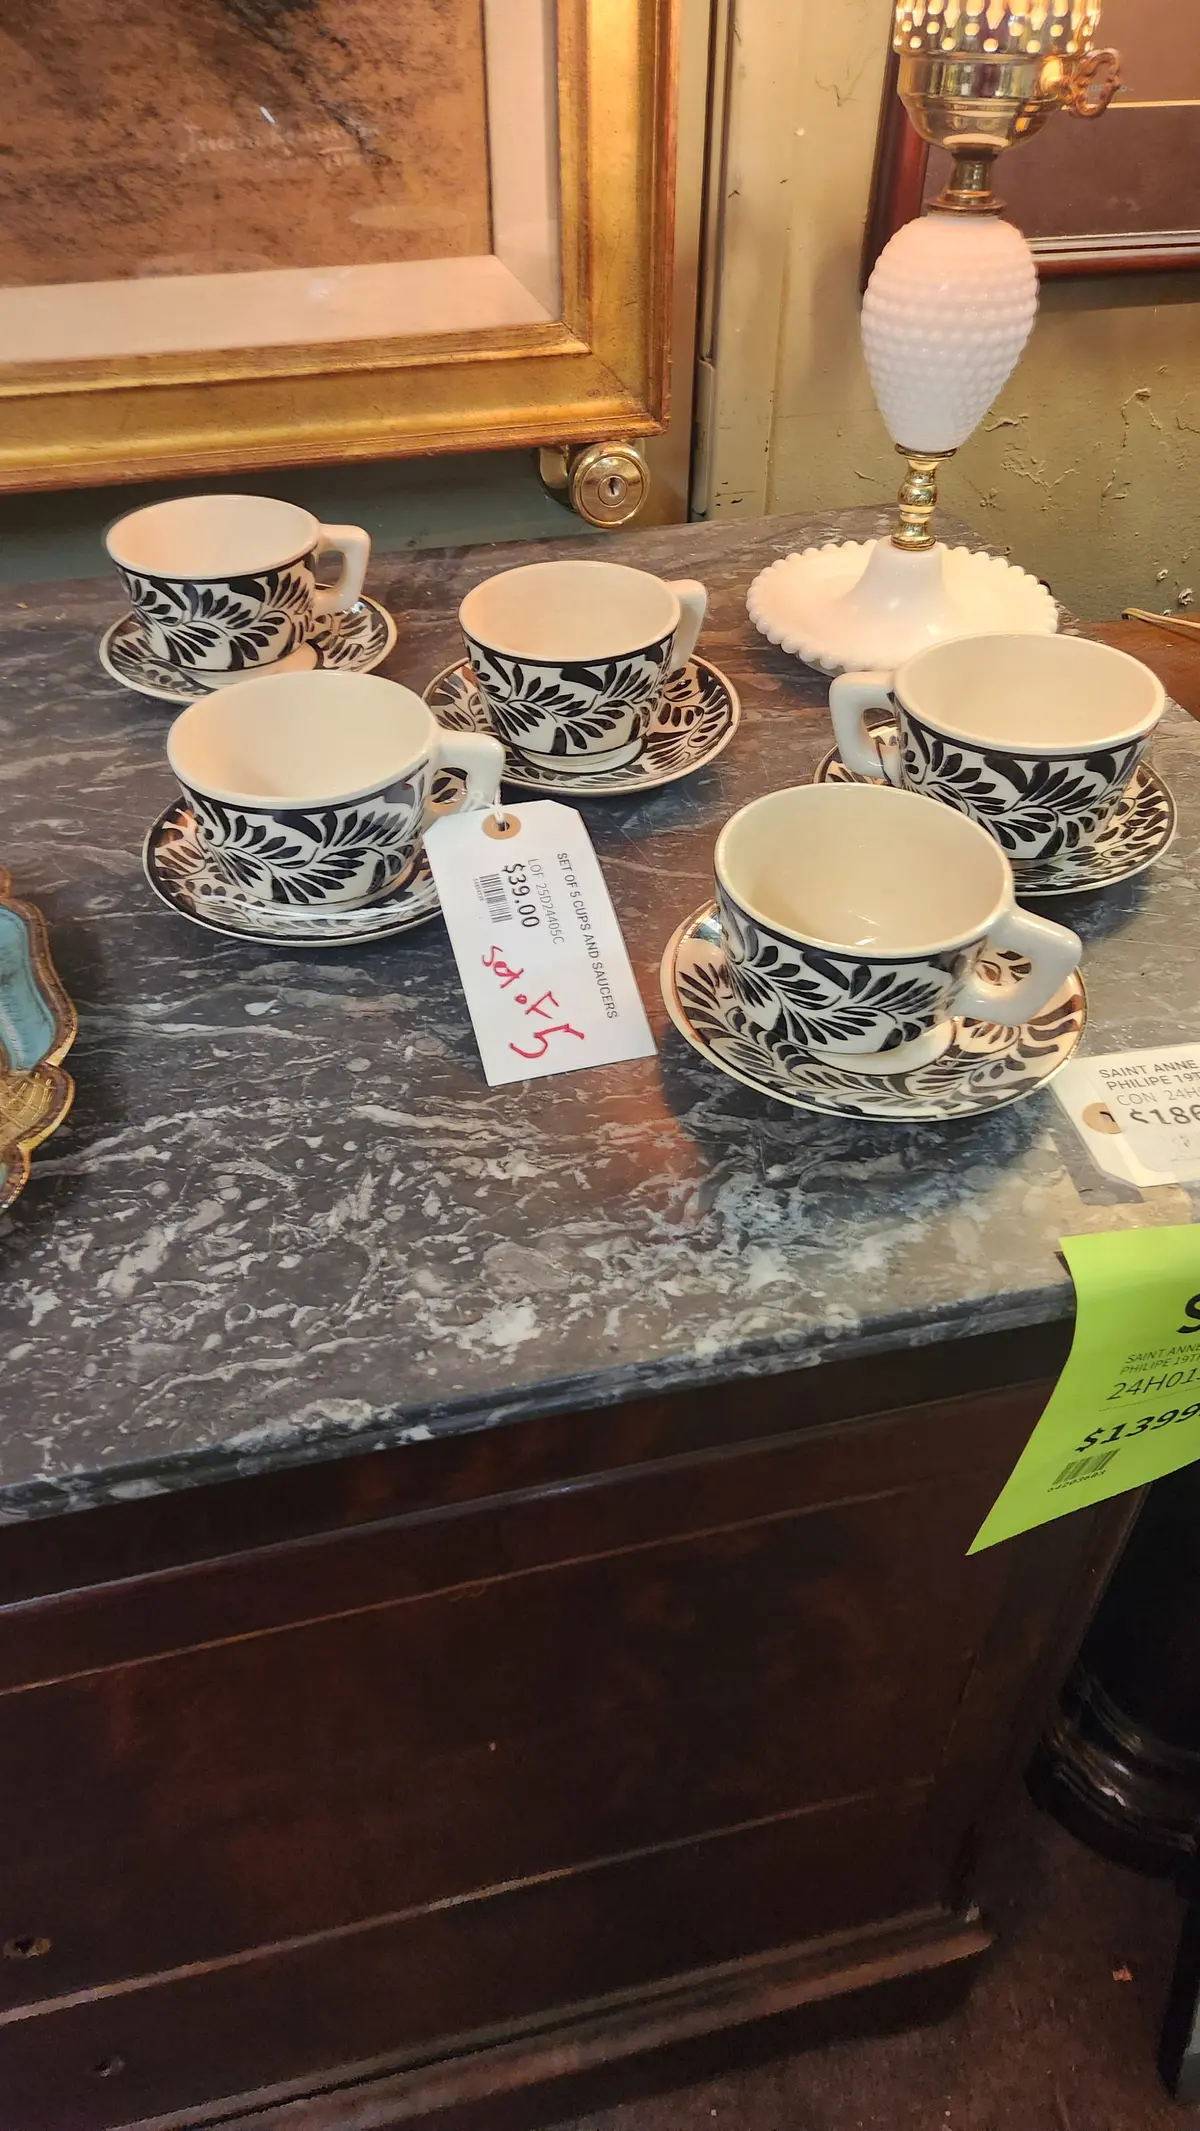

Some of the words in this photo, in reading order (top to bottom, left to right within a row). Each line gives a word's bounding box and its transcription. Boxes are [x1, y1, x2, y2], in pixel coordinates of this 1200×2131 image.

[557, 852, 573, 871] SET
[564, 874, 579, 888] OF
[501, 863, 540, 928] $39.00
[573, 900, 591, 931] CUPS
[583, 934, 600, 959] AND
[592, 961, 618, 1019] SAUCERS
[1099, 1065, 1148, 1079] SAINT
[1154, 1060, 1200, 1073] ANNE
[1106, 1075, 1173, 1091] PHILIPE
[1116, 1092, 1158, 1106] CON
[1164, 1084, 1200, 1101] 24H
[1120, 1357, 1169, 1375] PHILIPE
[1126, 1349, 1164, 1364] SAINT
[1106, 1368, 1200, 1401] 24H01
